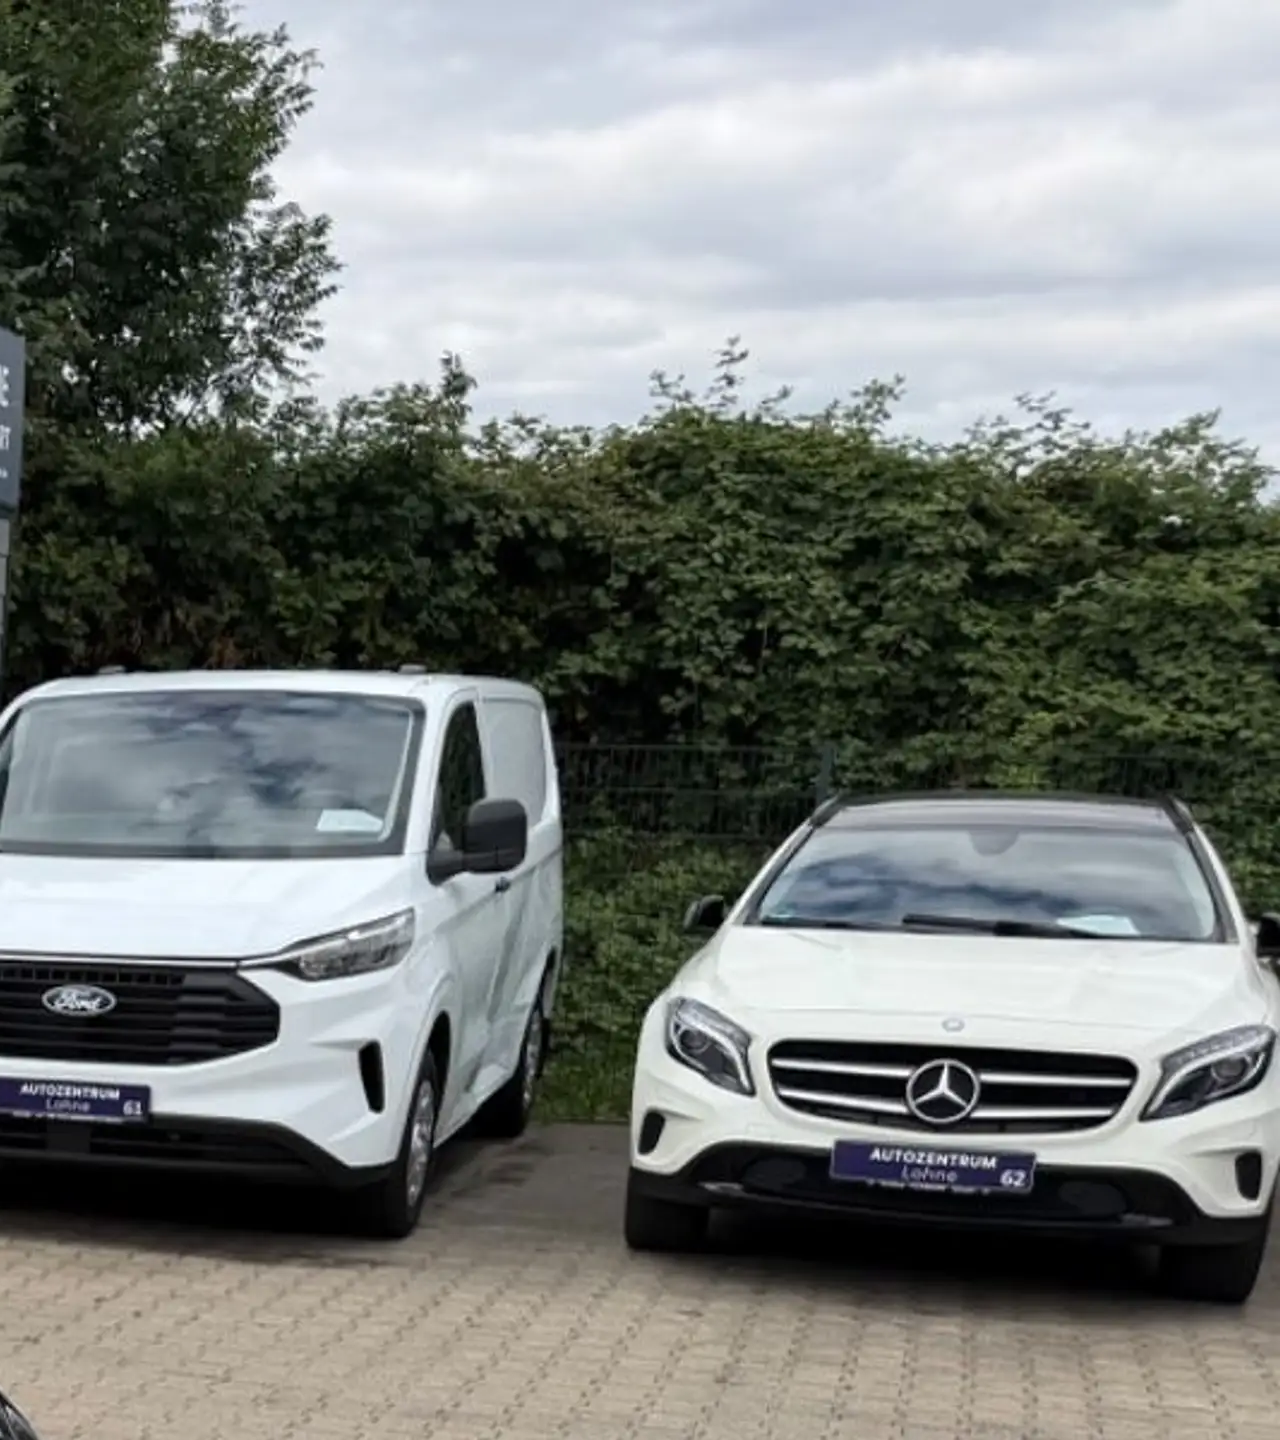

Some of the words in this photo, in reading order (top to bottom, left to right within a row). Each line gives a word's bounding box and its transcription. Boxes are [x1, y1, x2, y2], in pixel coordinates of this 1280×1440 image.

[19, 1082, 121, 1100] AUTOZENTRUM
[46, 1098, 91, 1113] Lohne
[869, 1146, 998, 1170] AUTOZENTRUM
[901, 1164, 959, 1183] Lohne
[1000, 1168, 1027, 1188] 62
